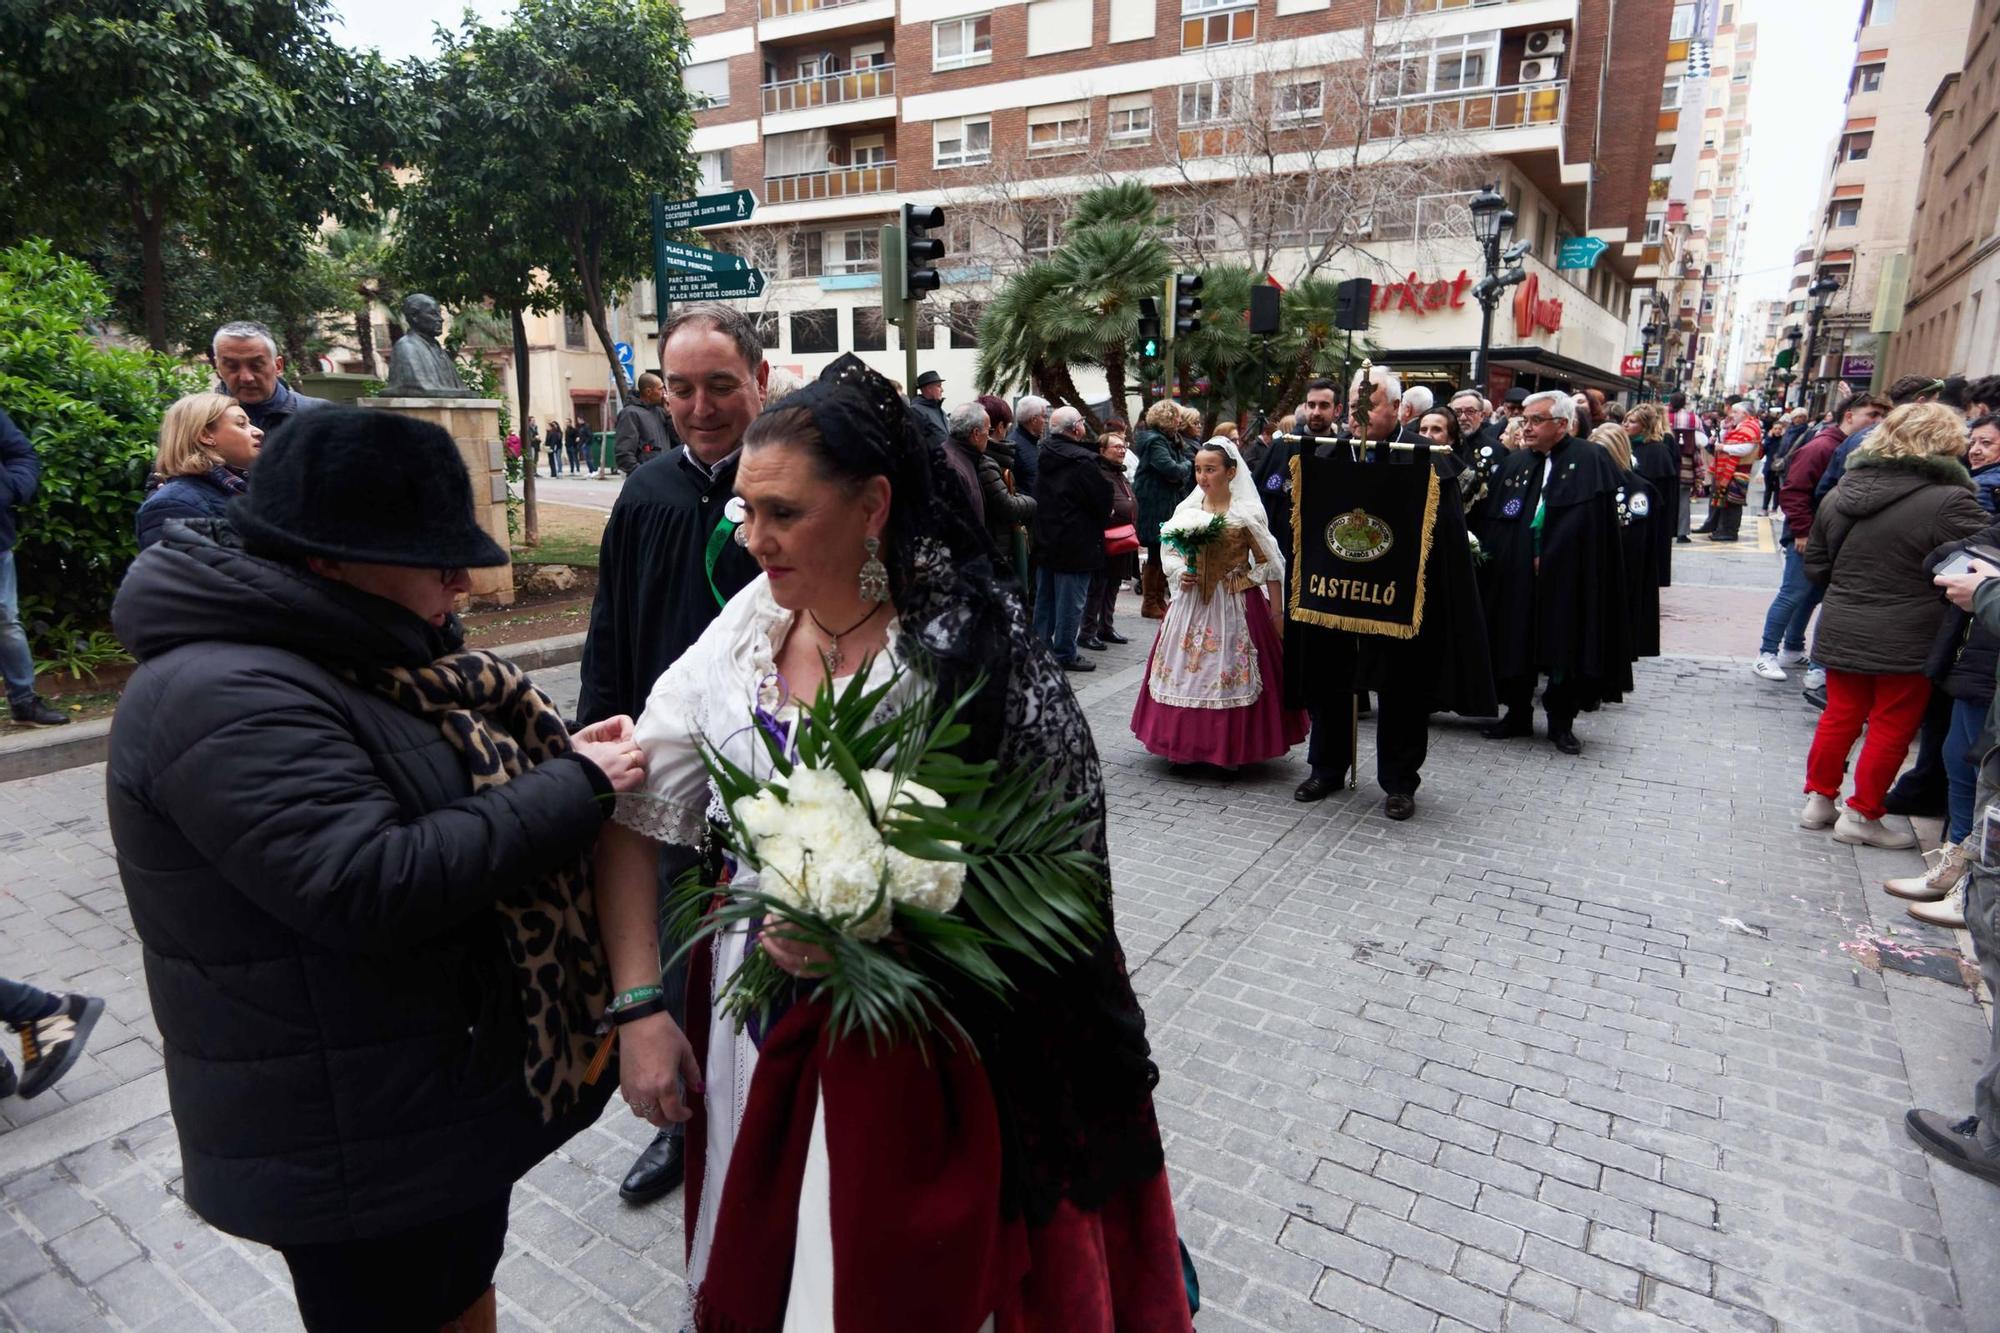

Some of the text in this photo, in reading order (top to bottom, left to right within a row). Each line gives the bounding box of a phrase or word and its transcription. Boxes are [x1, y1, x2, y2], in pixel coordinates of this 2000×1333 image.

[665, 211, 693, 219] COCATEDRAL
[666, 245, 684, 254] PLAÇA
[667, 257, 713, 272] TEATRE PRINCIPAL
[1310, 574, 1396, 605] CASTELLÓ
